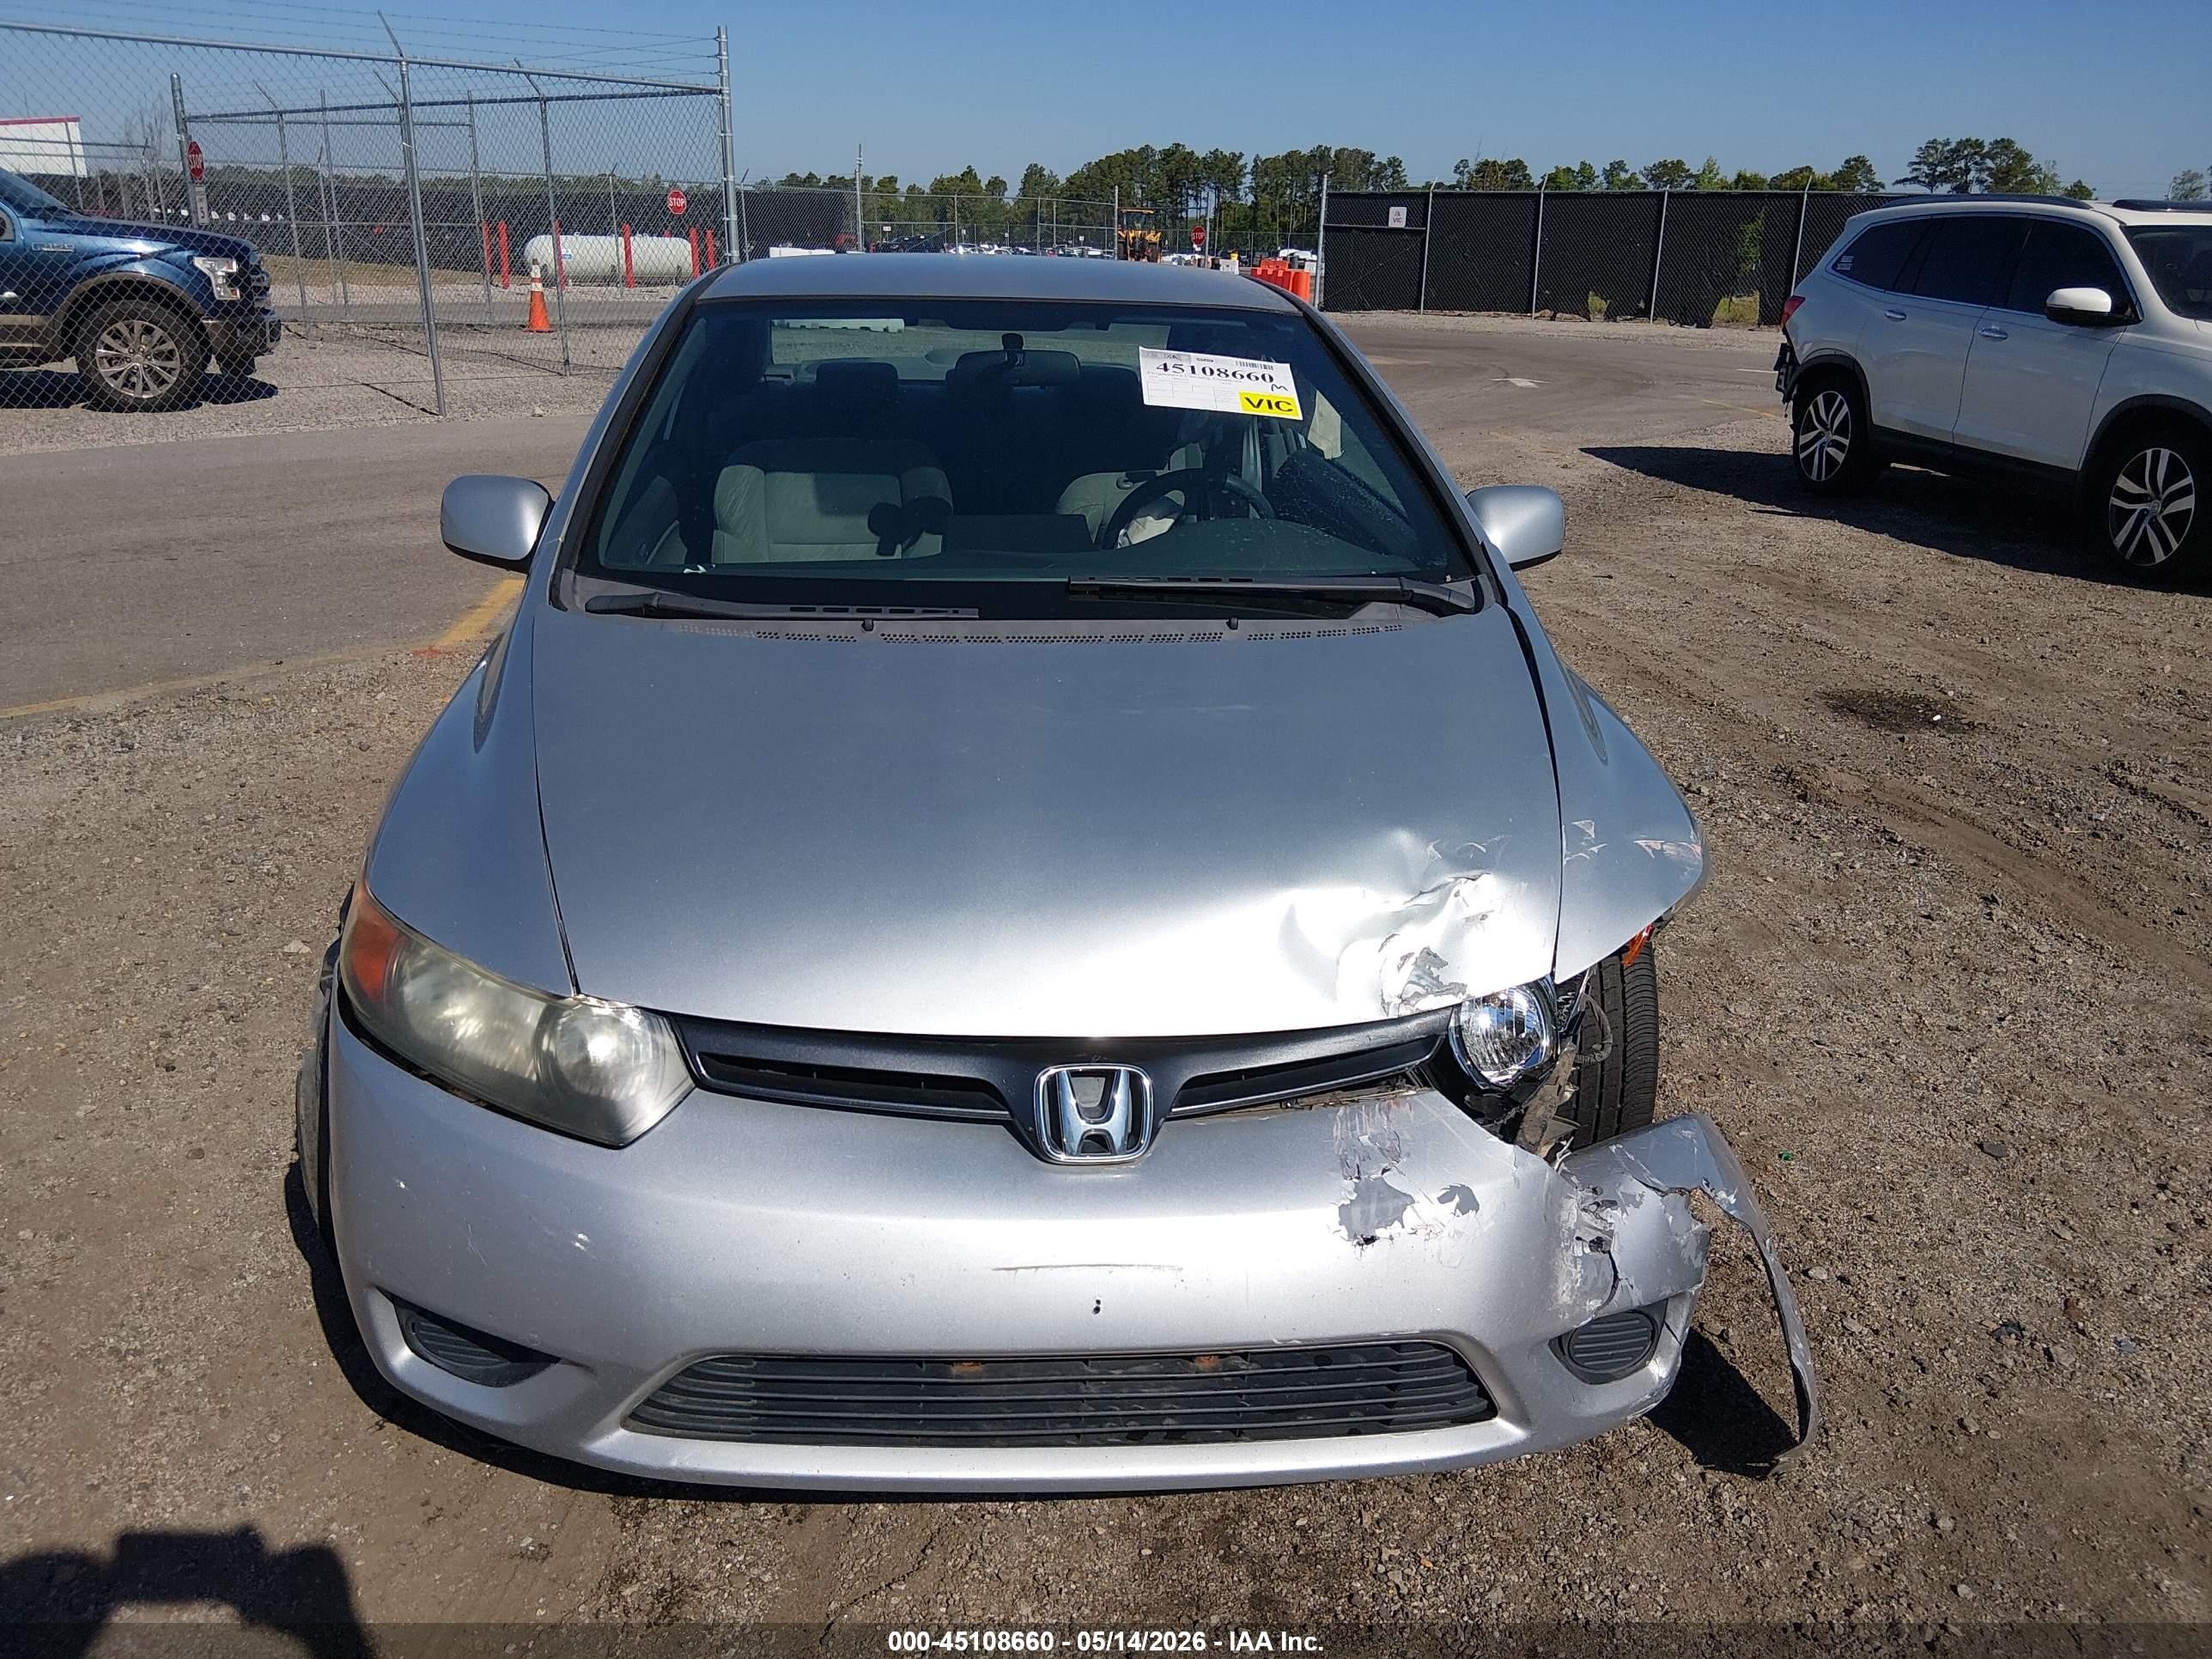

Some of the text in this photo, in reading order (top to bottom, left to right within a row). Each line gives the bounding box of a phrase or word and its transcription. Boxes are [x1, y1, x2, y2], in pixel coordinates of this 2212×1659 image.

[188, 154, 204, 170] STOP
[669, 198, 685, 207] STOP
[1156, 362, 1274, 384] 45108660
[1243, 396, 1294, 412] VIC
